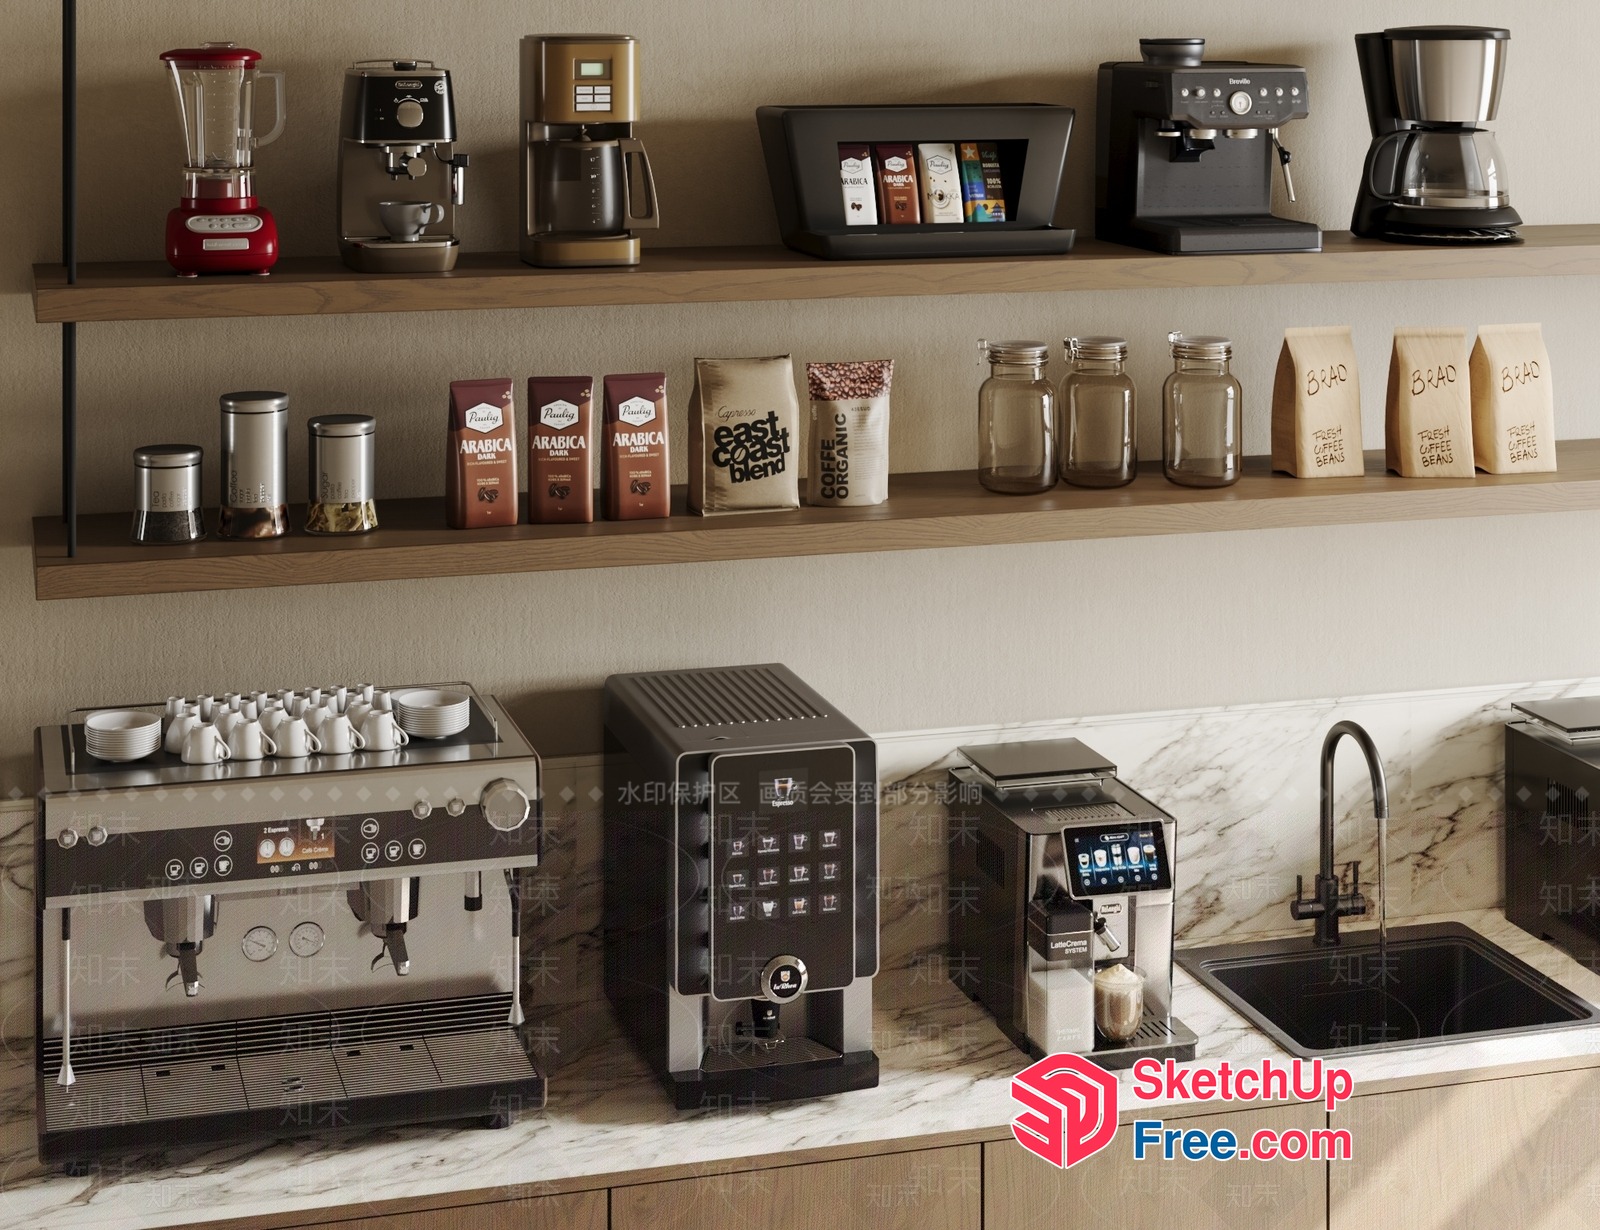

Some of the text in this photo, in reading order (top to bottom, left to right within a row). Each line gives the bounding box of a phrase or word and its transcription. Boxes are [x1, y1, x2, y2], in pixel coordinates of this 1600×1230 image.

[883, 174, 914, 182] ARABICA
[468, 411, 499, 424] Paulig
[544, 408, 575, 422] Paulig
[622, 405, 652, 418] Paulig
[716, 406, 756, 422] Capresso
[714, 410, 780, 448] east
[1312, 424, 1342, 442] FRESH
[1418, 425, 1450, 442] FRESH
[1506, 421, 1536, 438] FRESH
[460, 438, 512, 454] ARABICA
[532, 435, 586, 450] ARABICA
[612, 431, 664, 446] ARABICA
[630, 445, 648, 454] DARK
[712, 427, 790, 468] coast
[478, 452, 496, 460] DARK
[834, 413, 848, 500] ORGANIC
[1316, 452, 1345, 468] BEANS
[1422, 453, 1454, 468] BEANS
[1510, 448, 1538, 464] BEANS
[730, 452, 786, 484] blend
[820, 439, 836, 499] COFFE
[230, 470, 238, 503] Coffee
[321, 472, 330, 499] Sugar
[772, 800, 794, 808] Espresso
[1050, 940, 1088, 949] LatteCrema
